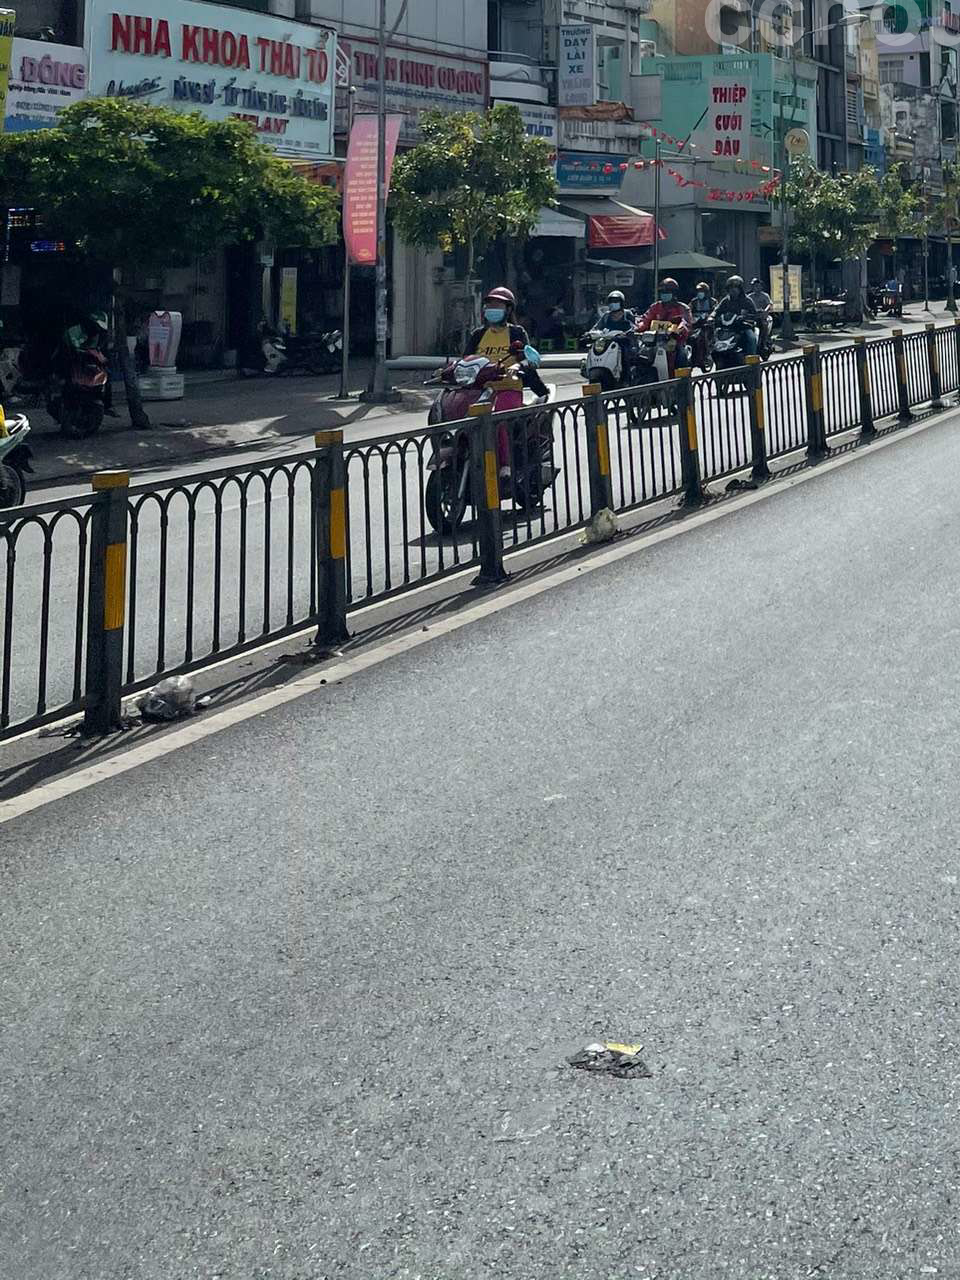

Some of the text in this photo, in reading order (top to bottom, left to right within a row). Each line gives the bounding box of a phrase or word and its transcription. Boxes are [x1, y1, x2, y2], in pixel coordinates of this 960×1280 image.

[110, 12, 172, 58] NHA
[180, 23, 250, 70] KHOA
[256, 33, 301, 81] THÁI
[354, 50, 398, 82] THM
[568, 64, 584, 74] XE
[712, 83, 748, 106] THIỆP
